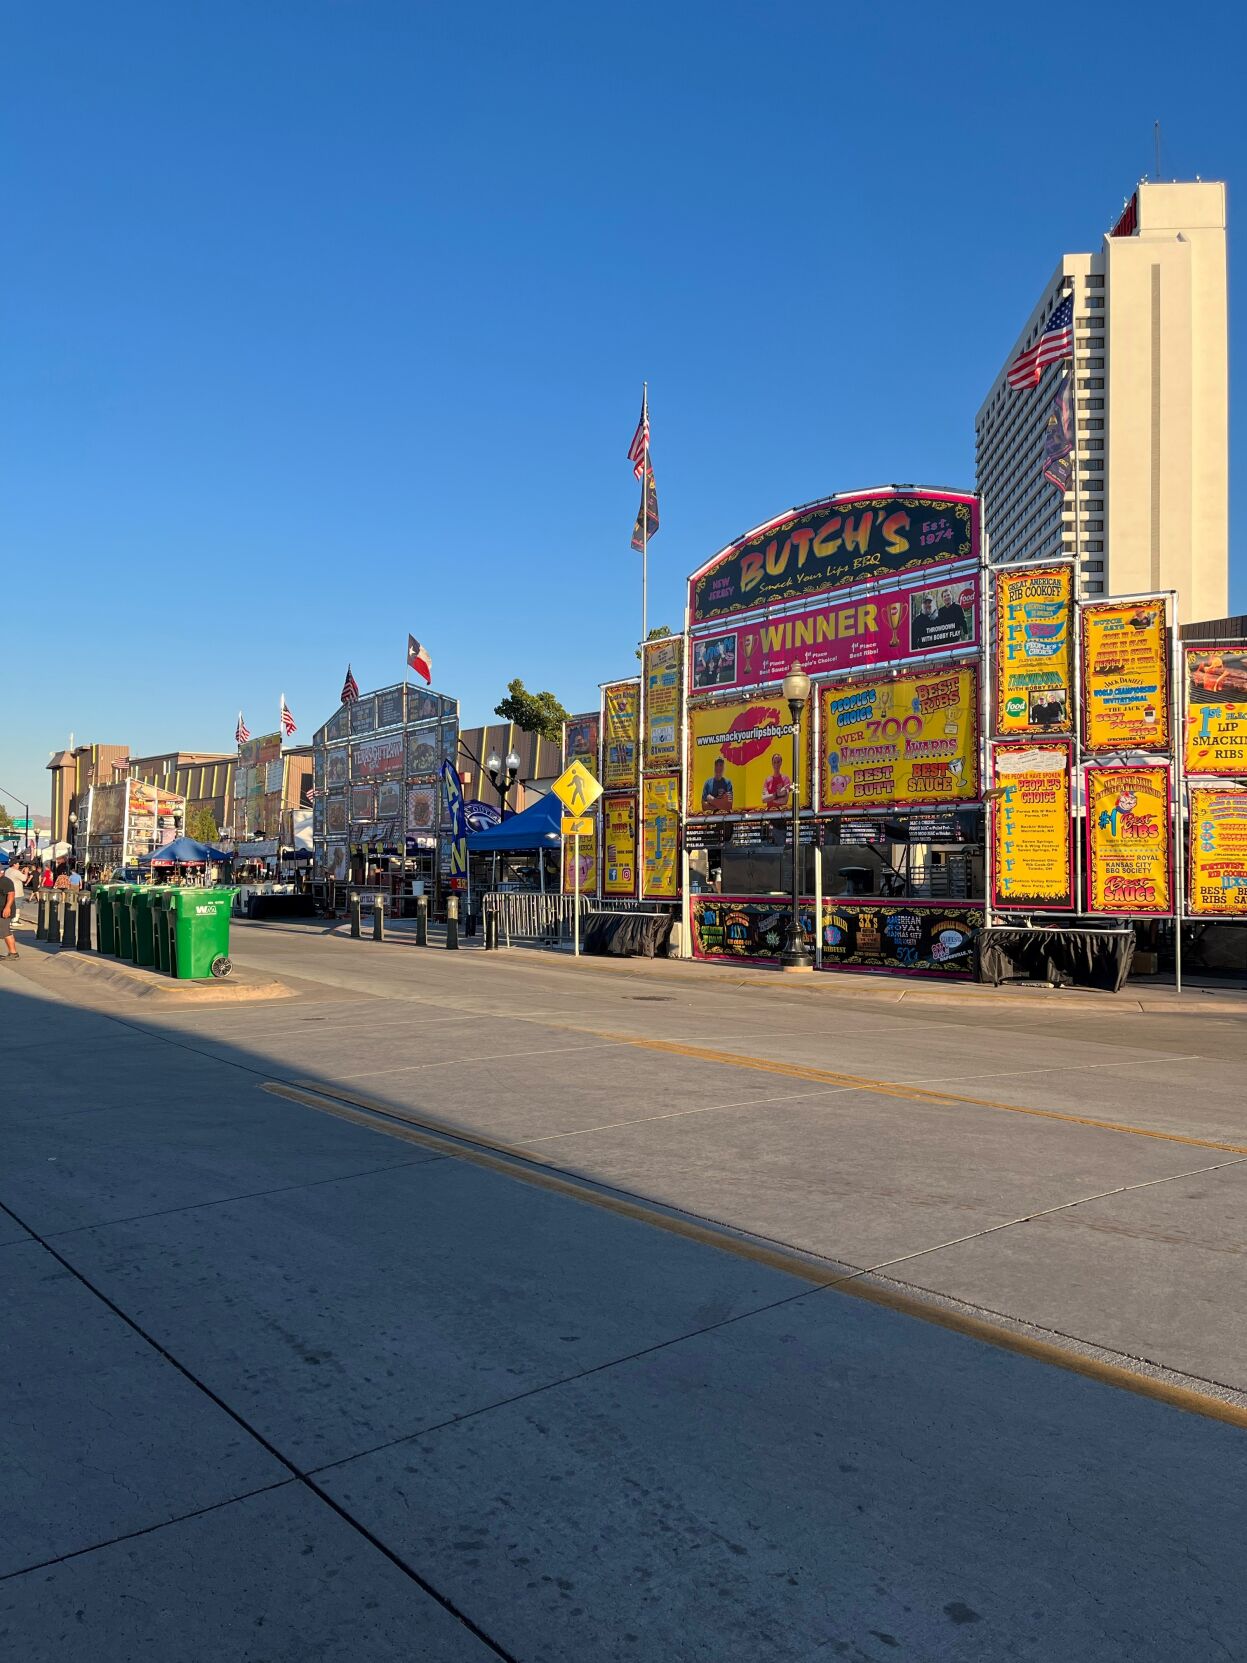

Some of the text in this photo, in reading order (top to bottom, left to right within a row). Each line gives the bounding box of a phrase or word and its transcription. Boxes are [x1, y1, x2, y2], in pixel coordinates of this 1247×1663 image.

[922, 518, 949, 533] Est.
[919, 528, 954, 546] 1974
[740, 510, 911, 592] BUTCH'S
[759, 553, 881, 594] Smack Your Lips BBQ
[712, 577, 730, 590] NEW
[1008, 577, 1062, 592] GREAT AMERICAN
[708, 586, 735, 601] JERSEY
[959, 591, 976, 604] food
[1009, 584, 1062, 603] RIB COOKOFF
[760, 603, 878, 654] WINNER
[926, 623, 956, 634] THROWDOWN
[921, 630, 961, 643] WITH BOBBY FLAY
[863, 649, 879, 657] Ribs!
[771, 665, 790, 673] Sauce!
[916, 677, 960, 701] BEST
[1094, 685, 1157, 697] WORLD CHAMPIONSHIP
[1104, 679, 1120, 688] JACK
[830, 689, 877, 715] PEOPLE'S
[920, 691, 960, 715] RIBS
[1006, 701, 1026, 711] food
[837, 706, 873, 727] CHOICE
[1095, 713, 1125, 722] BEST
[836, 715, 923, 745] OVER 700
[1110, 720, 1144, 729] PORK
[1128, 727, 1158, 736] RIBS
[1218, 723, 1239, 732] LIP
[697, 722, 801, 748] www.smackyourlipsbbq.co
[1192, 735, 1247, 746] SMACKI
[840, 738, 957, 765] NATIONAL AWARDS
[1215, 749, 1244, 758] RIBS
[854, 766, 893, 783] BEST
[912, 762, 949, 778] BEST
[854, 780, 894, 797] BUTT
[908, 777, 952, 792] SAUCE
[1017, 779, 1061, 792] PEOPLE'S
[1021, 792, 1056, 804] CHOICE
[1120, 811, 1157, 829] Best
[1121, 824, 1159, 839] RIBS
[1104, 876, 1156, 889] Best
[1104, 886, 1155, 902] SAUCE
[1200, 886, 1227, 895] BEST
[1202, 895, 1247, 904] RIBS SA
[858, 914, 879, 929] 3X's
[939, 950, 968, 962] NAPERVILLE,
